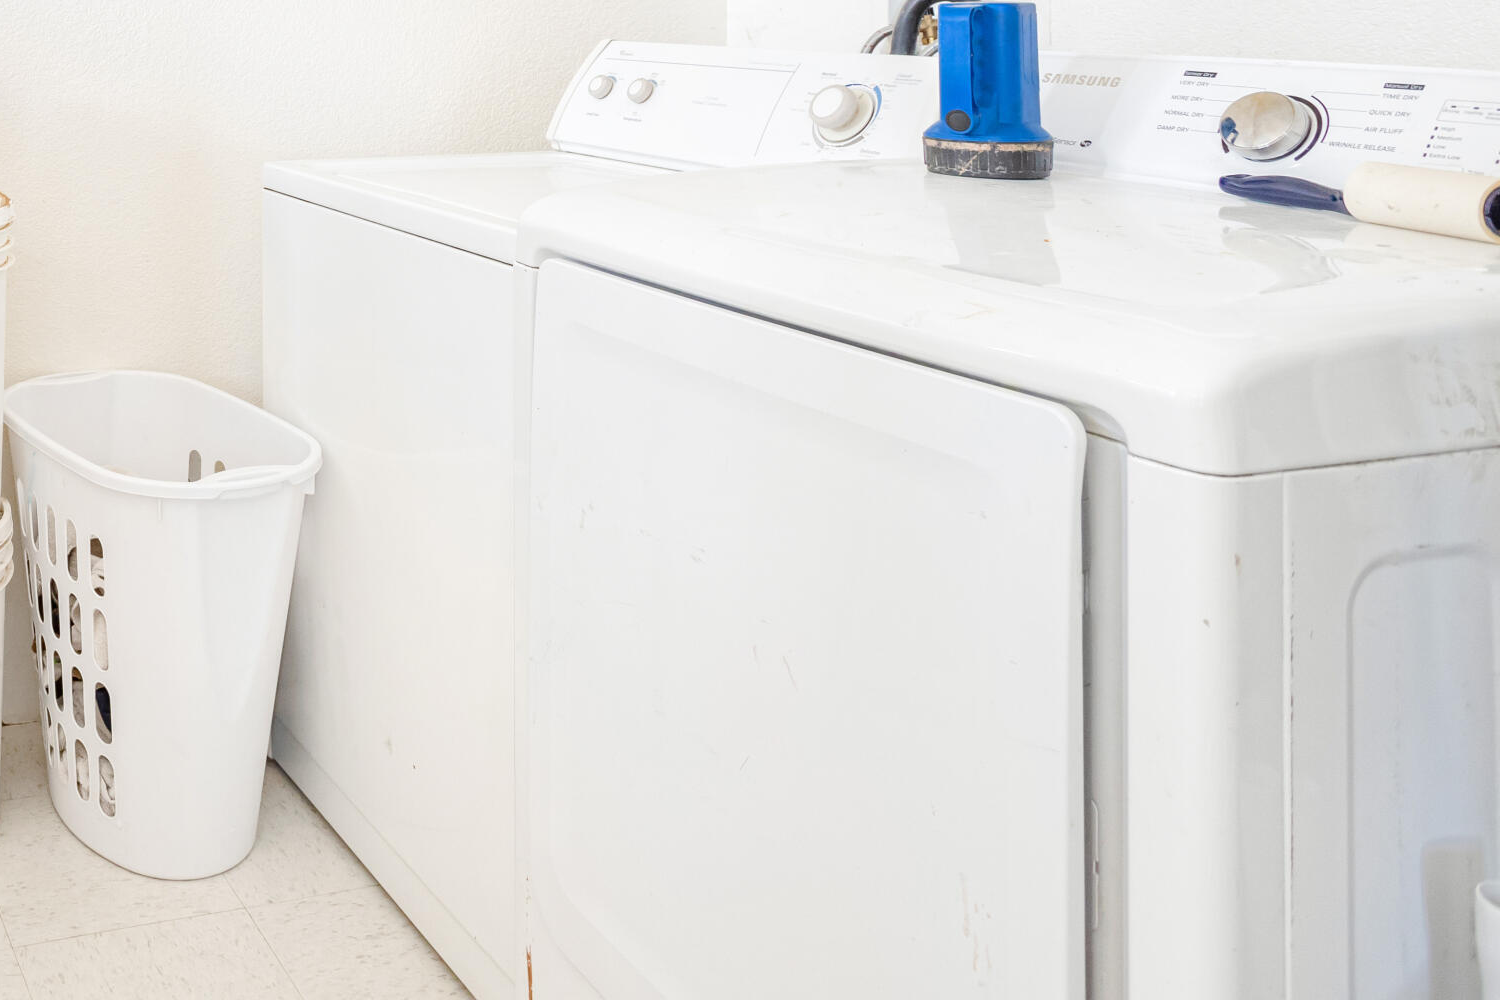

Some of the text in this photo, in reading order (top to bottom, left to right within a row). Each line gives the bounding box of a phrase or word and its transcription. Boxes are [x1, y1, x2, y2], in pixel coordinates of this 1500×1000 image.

[1041, 72, 1122, 88] SAMSUNG
[1328, 141, 1397, 152] WRINKLE RELEASE
